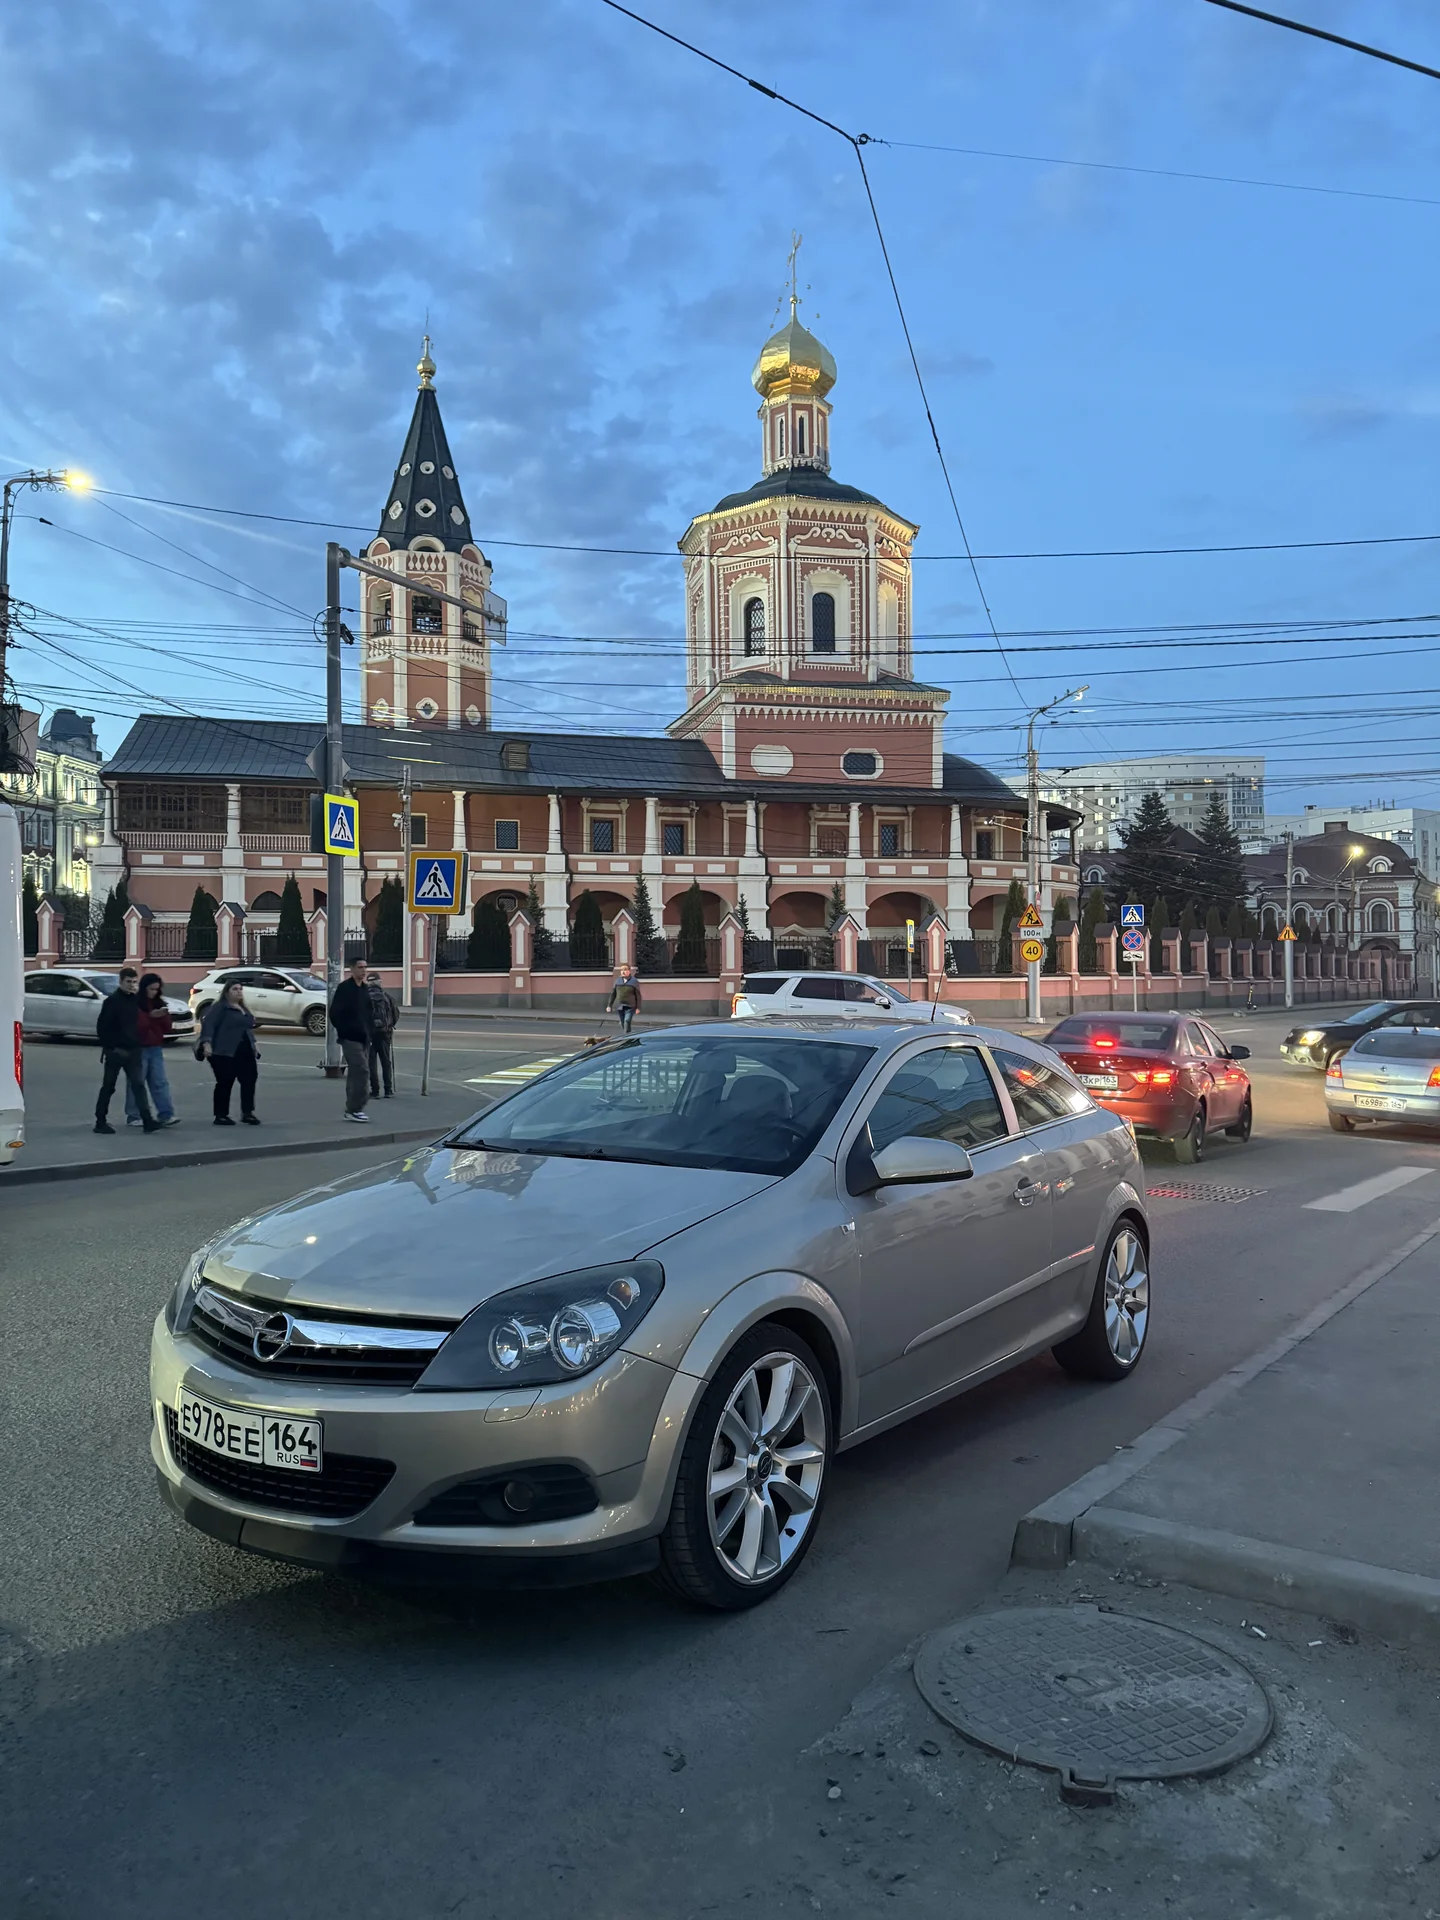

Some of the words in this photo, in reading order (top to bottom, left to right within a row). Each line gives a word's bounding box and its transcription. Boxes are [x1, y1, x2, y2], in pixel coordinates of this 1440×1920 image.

[1026, 946, 1039, 955] 40
[267, 1422, 313, 1455] 164
[277, 1452, 300, 1464] RUS
